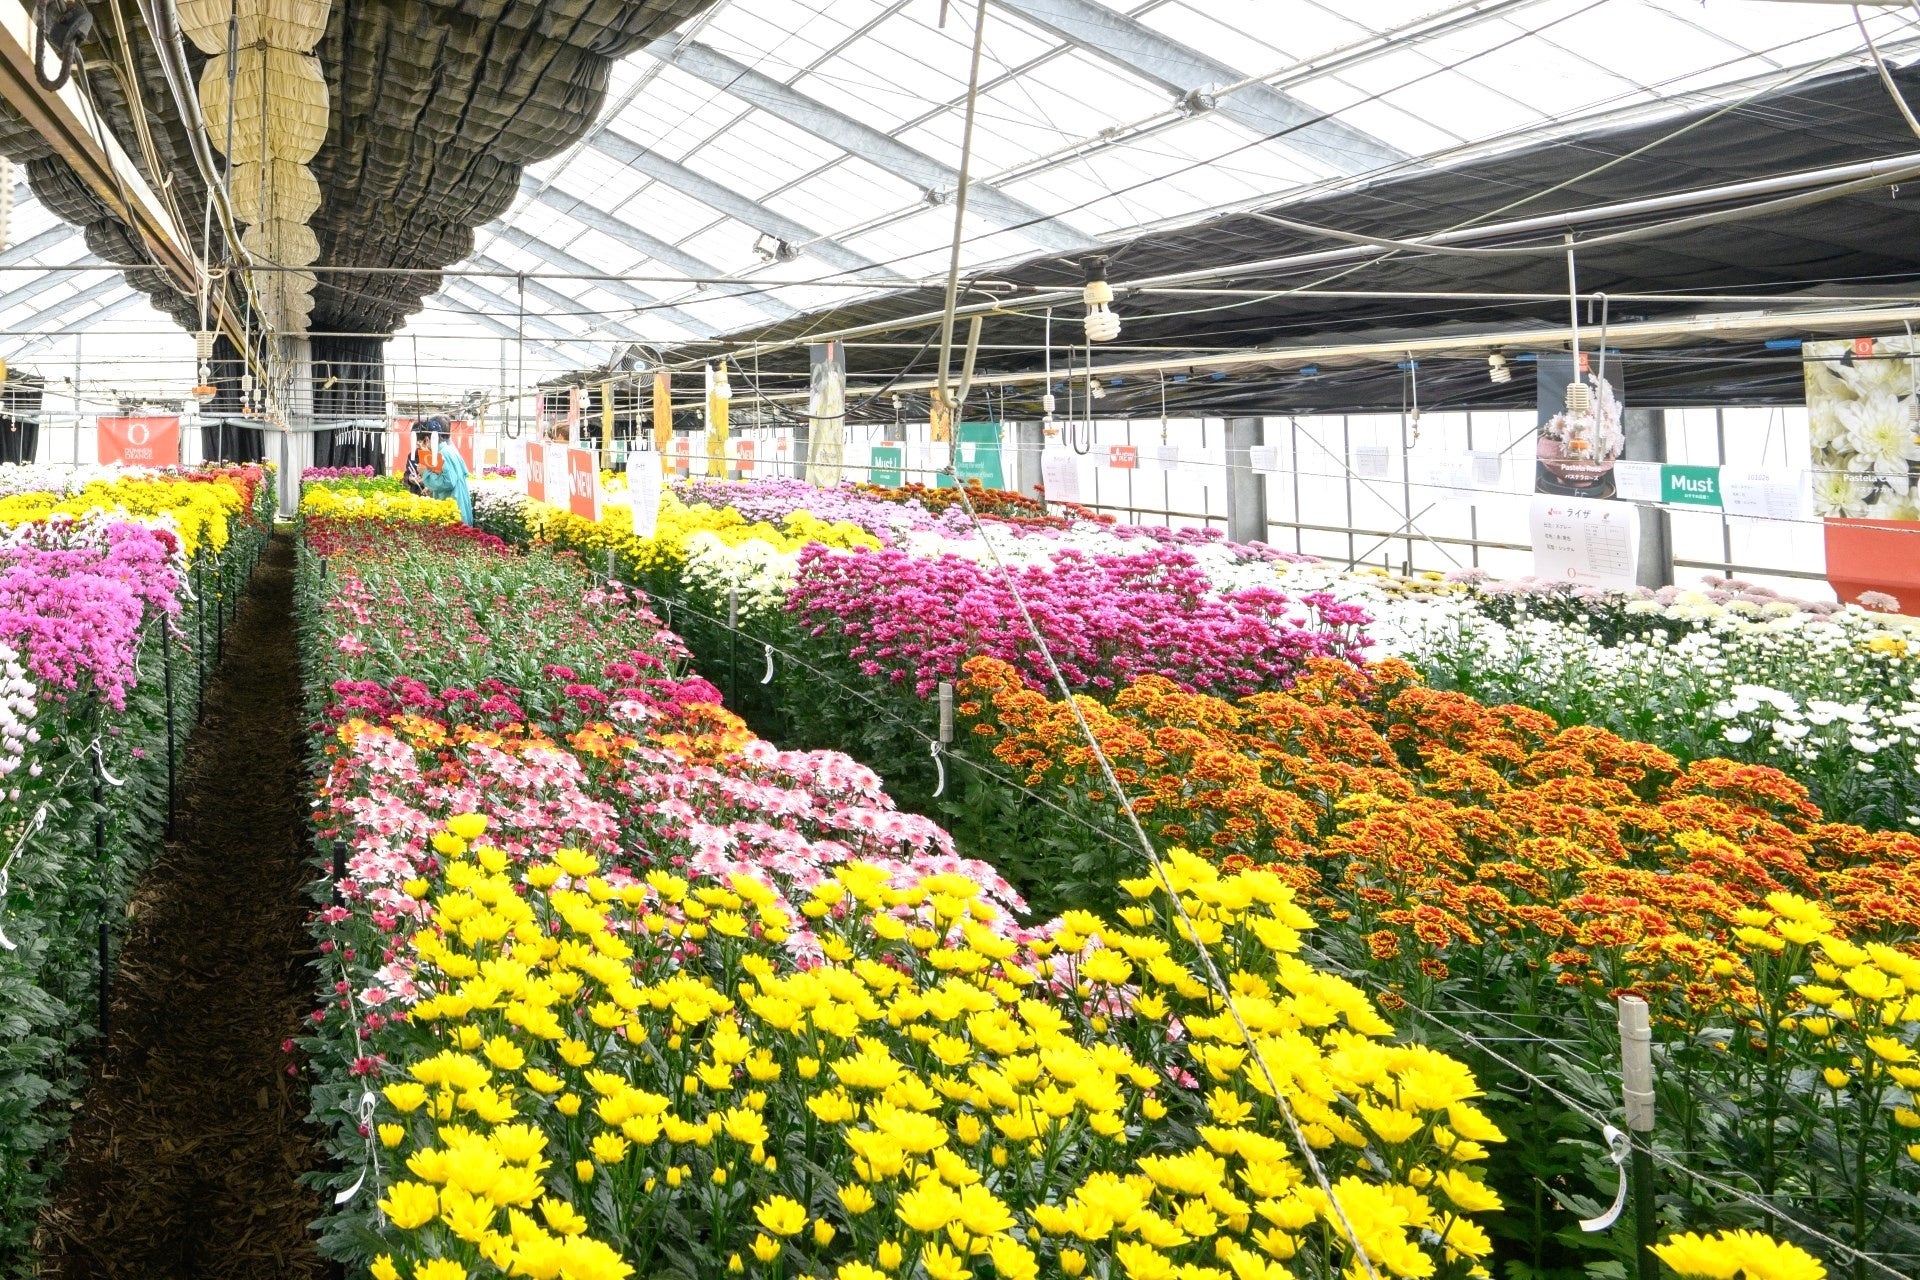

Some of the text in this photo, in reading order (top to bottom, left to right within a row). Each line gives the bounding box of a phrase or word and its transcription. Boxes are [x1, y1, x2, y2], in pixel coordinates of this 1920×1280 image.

[1118, 452, 1135, 462] NEW
[533, 460, 544, 484] NEW
[1560, 463, 1602, 473] Pastela Rose
[1843, 473, 1877, 482] Pastela
[576, 469, 593, 499] NEW
[1671, 474, 1714, 493] Must
[1567, 508, 1592, 519] ライザ
